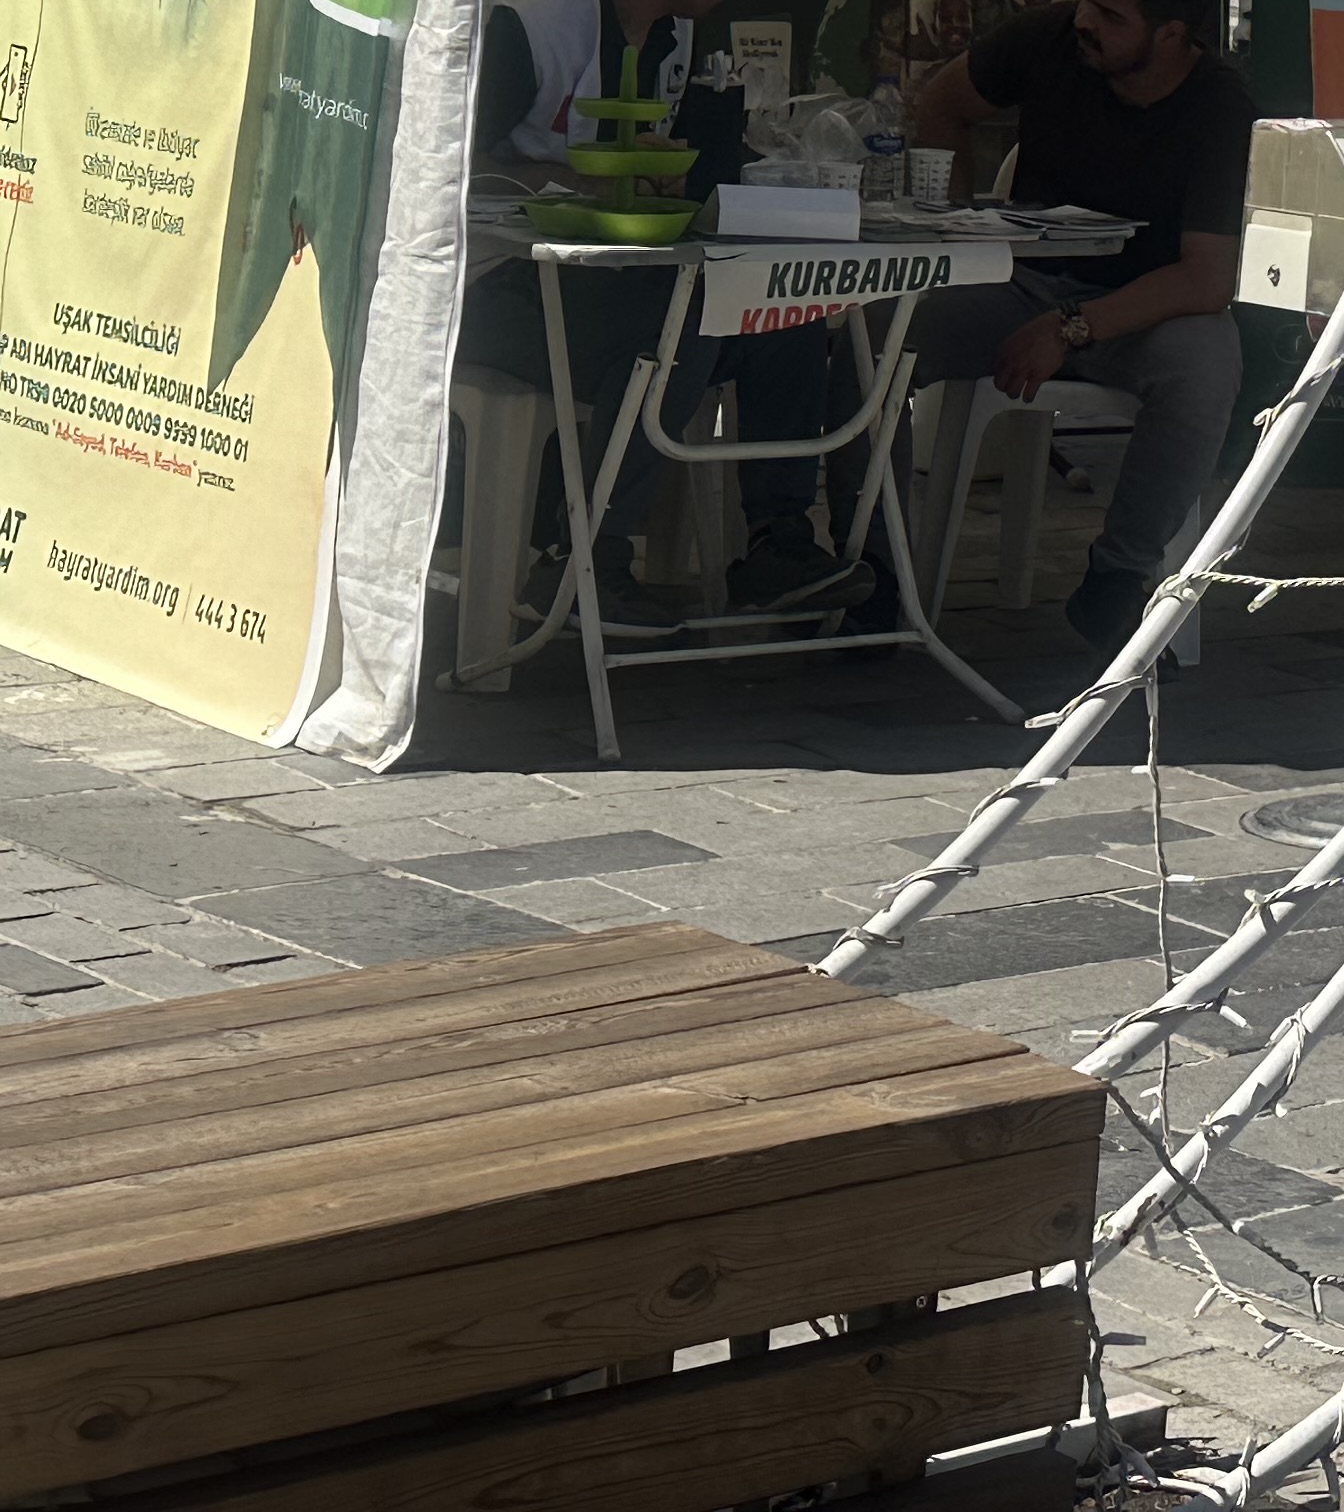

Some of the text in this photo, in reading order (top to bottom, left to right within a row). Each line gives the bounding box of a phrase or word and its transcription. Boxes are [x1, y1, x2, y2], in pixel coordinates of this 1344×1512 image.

[766, 255, 951, 298] KURBANDA
[53, 303, 93, 334] UŞAK
[10, 337, 32, 364] ADI
[33, 342, 92, 378] HAYRAT
[91, 352, 142, 392] İNSANİ
[143, 370, 194, 407] YARDIM
[195, 385, 255, 424] DERNEĞİ
[52, 386, 87, 415] 0020
[89, 395, 123, 426] 5000
[200, 427, 231, 458] 1000
[233, 438, 249, 463] 01
[47, 539, 180, 617] hayratyardim.org
[195, 593, 224, 629] 444
[226, 602, 238, 634] 3
[240, 608, 267, 645] 674
